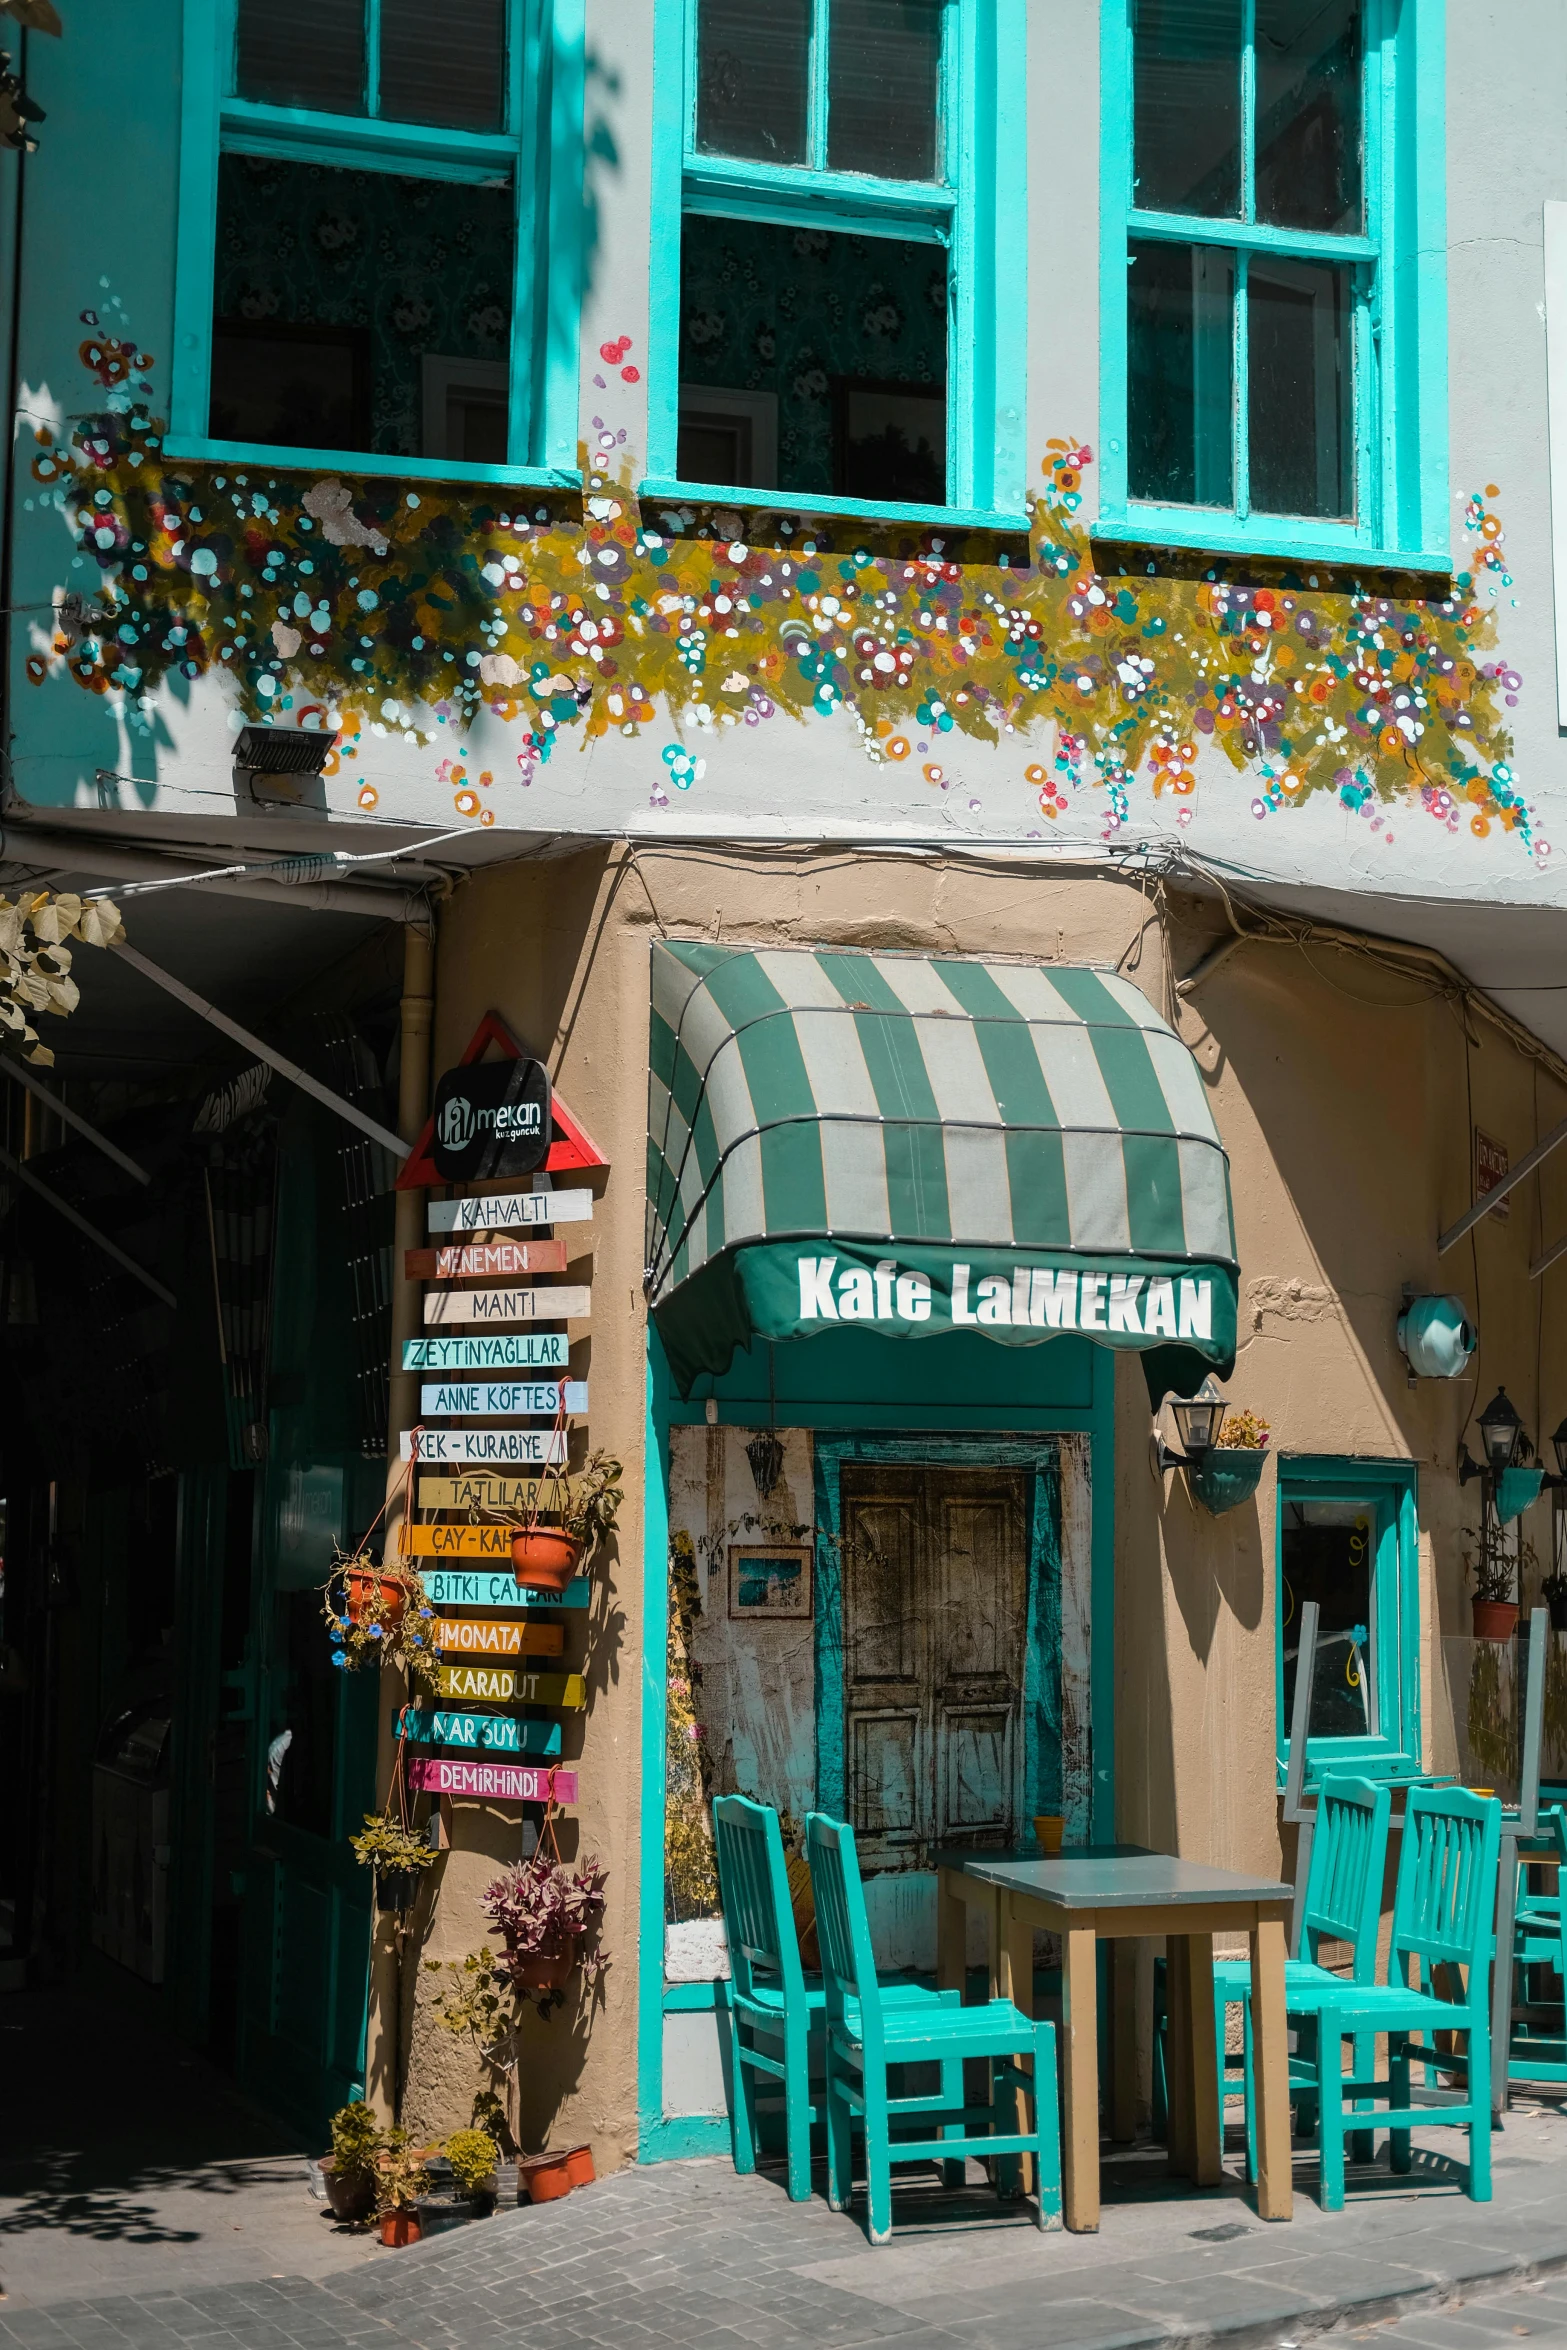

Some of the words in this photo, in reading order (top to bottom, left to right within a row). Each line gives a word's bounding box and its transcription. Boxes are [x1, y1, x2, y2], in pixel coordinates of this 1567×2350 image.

[477, 1103, 540, 1130] mekan
[496, 1126, 540, 1142] kuzguncuk
[461, 1195, 548, 1228] KAHVALTI
[436, 1246, 529, 1275] MENEMEN
[797, 1256, 931, 1321] Kafe
[473, 1292, 535, 1318] MANTI
[411, 1337, 562, 1367] ZEYTİNYAĞLILAR
[435, 1387, 480, 1411] ANNE
[487, 1386, 559, 1411] KÖFTES
[416, 1434, 447, 1458] KEK
[465, 1434, 543, 1460] KURABİYE
[450, 1480, 537, 1506] TATLILAR
[432, 1527, 466, 1553] ÇAY
[480, 1528, 513, 1553] KAH
[433, 1574, 479, 1601] BİTKİ
[433, 1622, 521, 1650] İMONATA
[450, 1669, 540, 1700] KARADUT
[433, 1714, 476, 1744] NAR
[482, 1721, 528, 1748] SUYU
[440, 1764, 538, 1798] DEMİRHİNDİ
